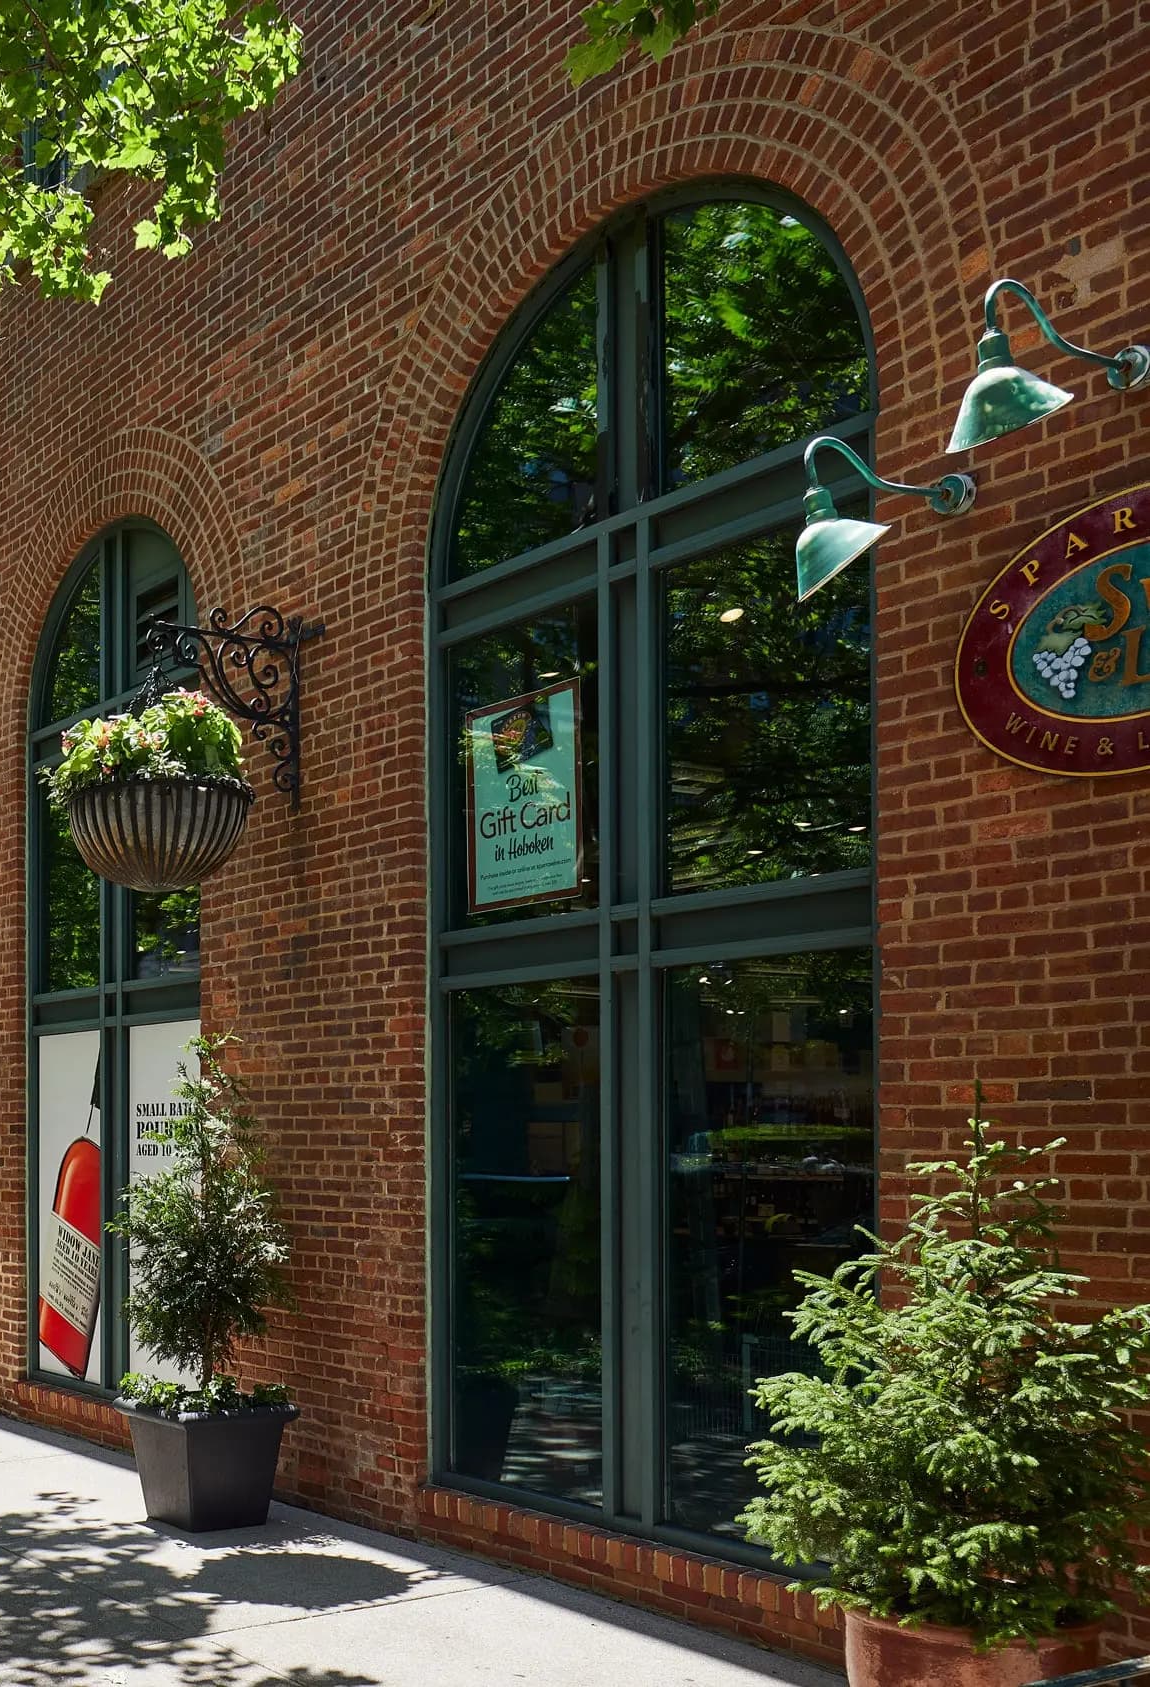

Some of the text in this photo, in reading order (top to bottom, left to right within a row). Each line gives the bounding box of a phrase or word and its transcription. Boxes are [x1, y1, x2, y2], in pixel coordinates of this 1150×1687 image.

[1004, 711, 1079, 755] WINE
[1096, 737, 1115, 756] &
[506, 770, 543, 802] Best
[480, 791, 570, 839] Gift Card
[495, 833, 554, 862] in Hoboken
[136, 1103, 167, 1117] SMALL
[136, 1144, 158, 1157] AGED
[162, 1144, 172, 1157] 10
[58, 1225, 82, 1253] WIDOW
[57, 1238, 70, 1255] AGED
[71, 1250, 80, 1263] 10
[80, 1256, 97, 1278] YEARS
